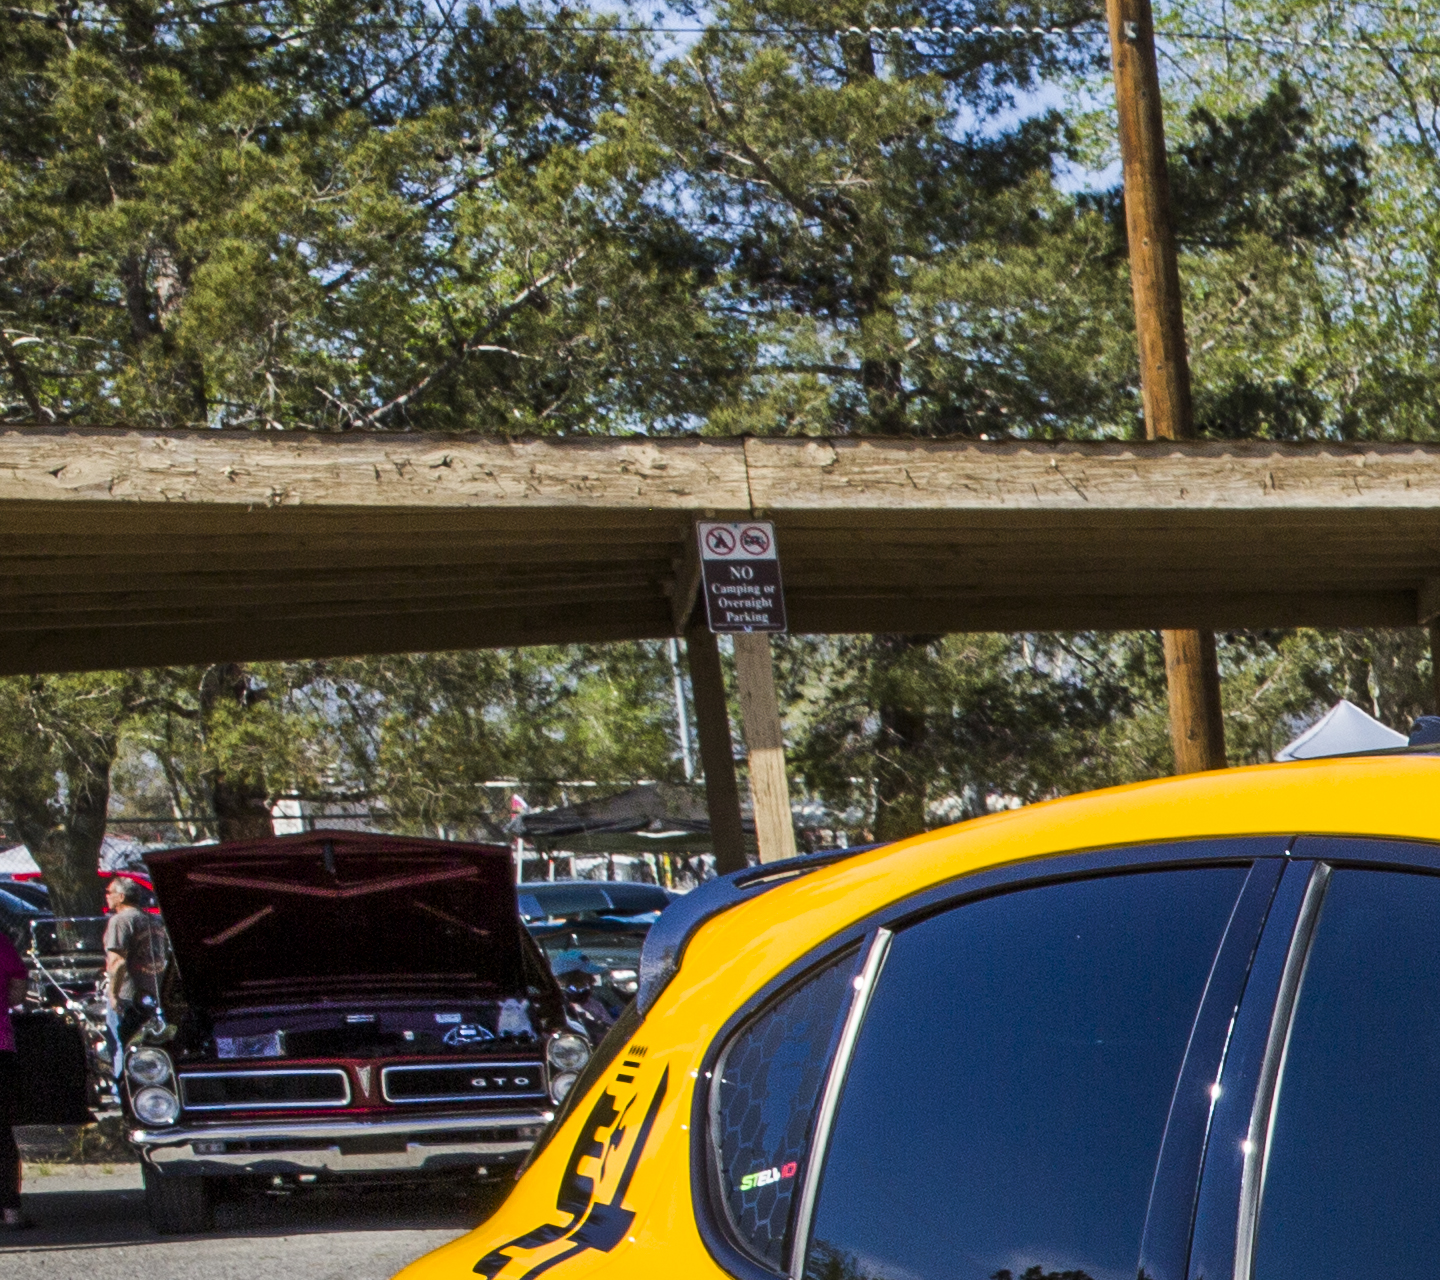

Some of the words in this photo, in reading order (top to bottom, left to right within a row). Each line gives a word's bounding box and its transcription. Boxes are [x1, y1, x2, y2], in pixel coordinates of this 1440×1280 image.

[729, 566, 754, 580] NO
[711, 583, 761, 596] Camping
[763, 585, 776, 595] or
[718, 597, 773, 611] Overnight
[726, 611, 769, 625] Parking
[471, 1076, 530, 1087] GTO
